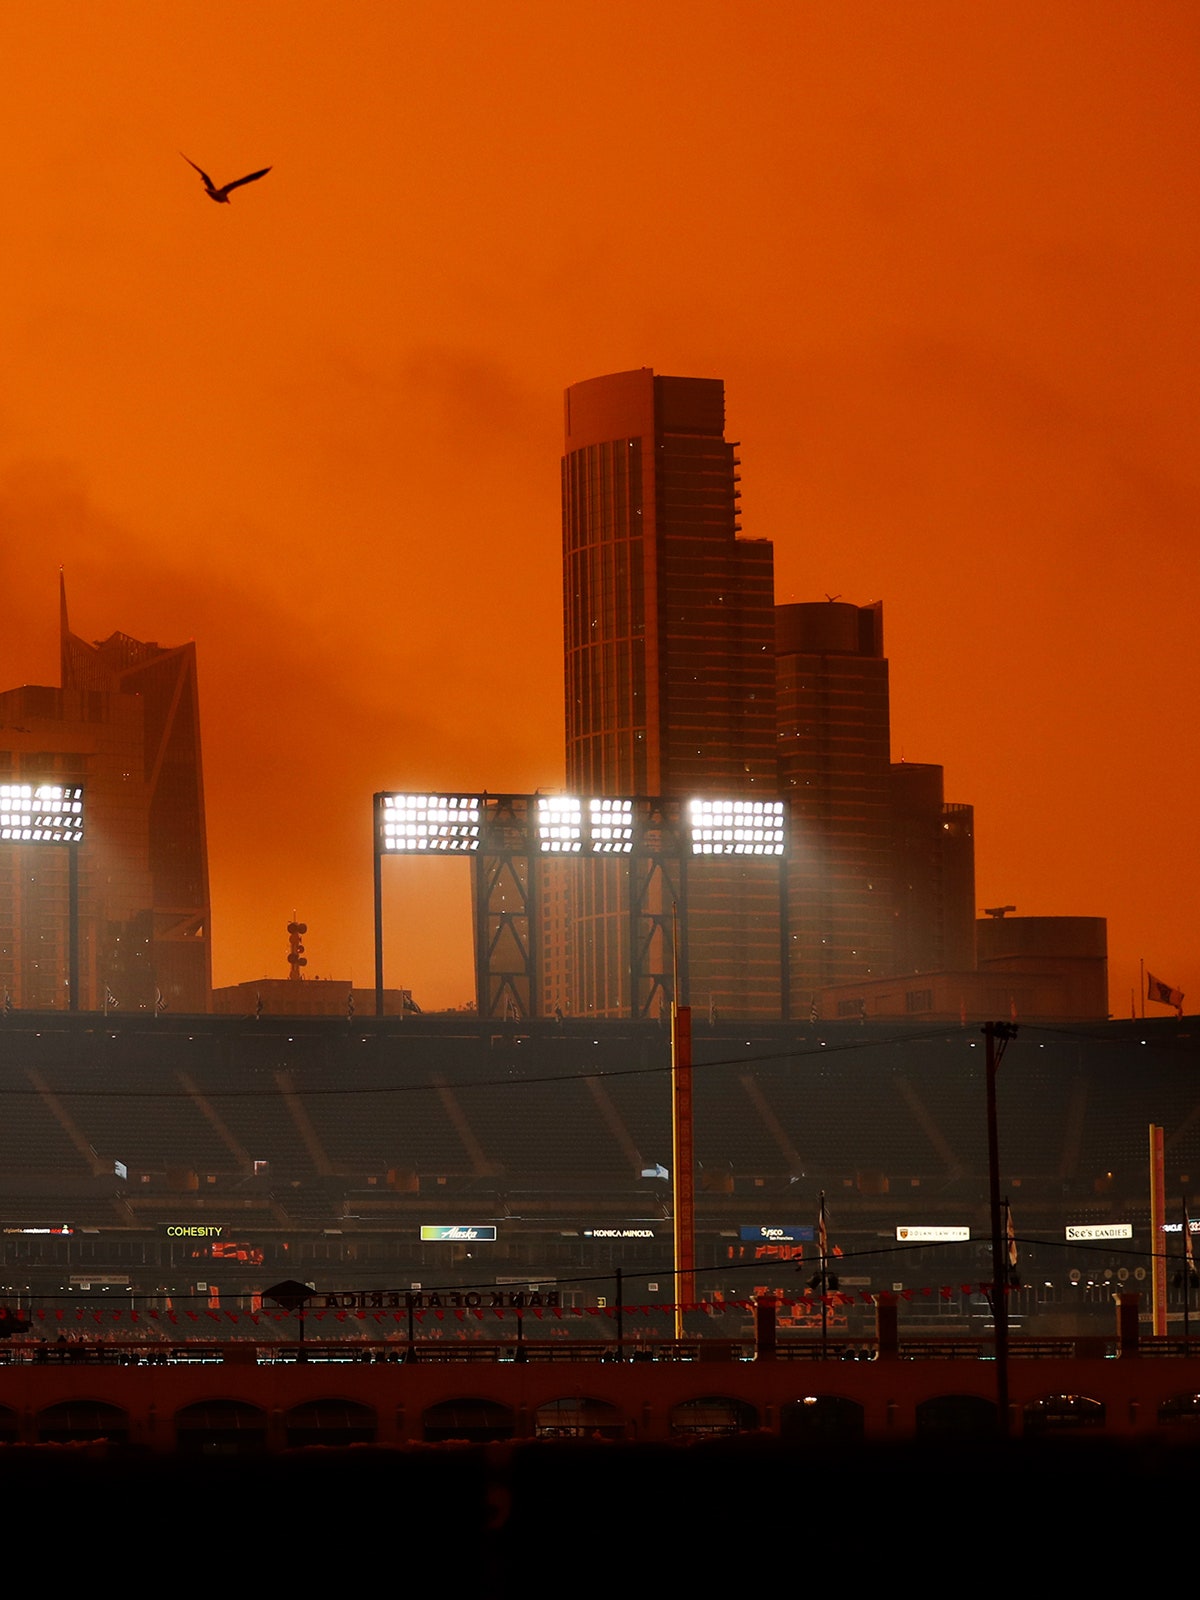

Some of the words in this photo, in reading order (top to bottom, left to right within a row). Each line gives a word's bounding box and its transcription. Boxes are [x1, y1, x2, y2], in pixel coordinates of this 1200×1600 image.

[166, 1226, 223, 1237] COHESITY
[441, 1226, 478, 1240] Alaska
[593, 1229, 621, 1238] KONICA
[622, 1229, 655, 1238] MINOLTA
[761, 1226, 784, 1238] Sysco
[1068, 1227, 1093, 1238] See's
[1094, 1229, 1128, 1237] CANDIES
